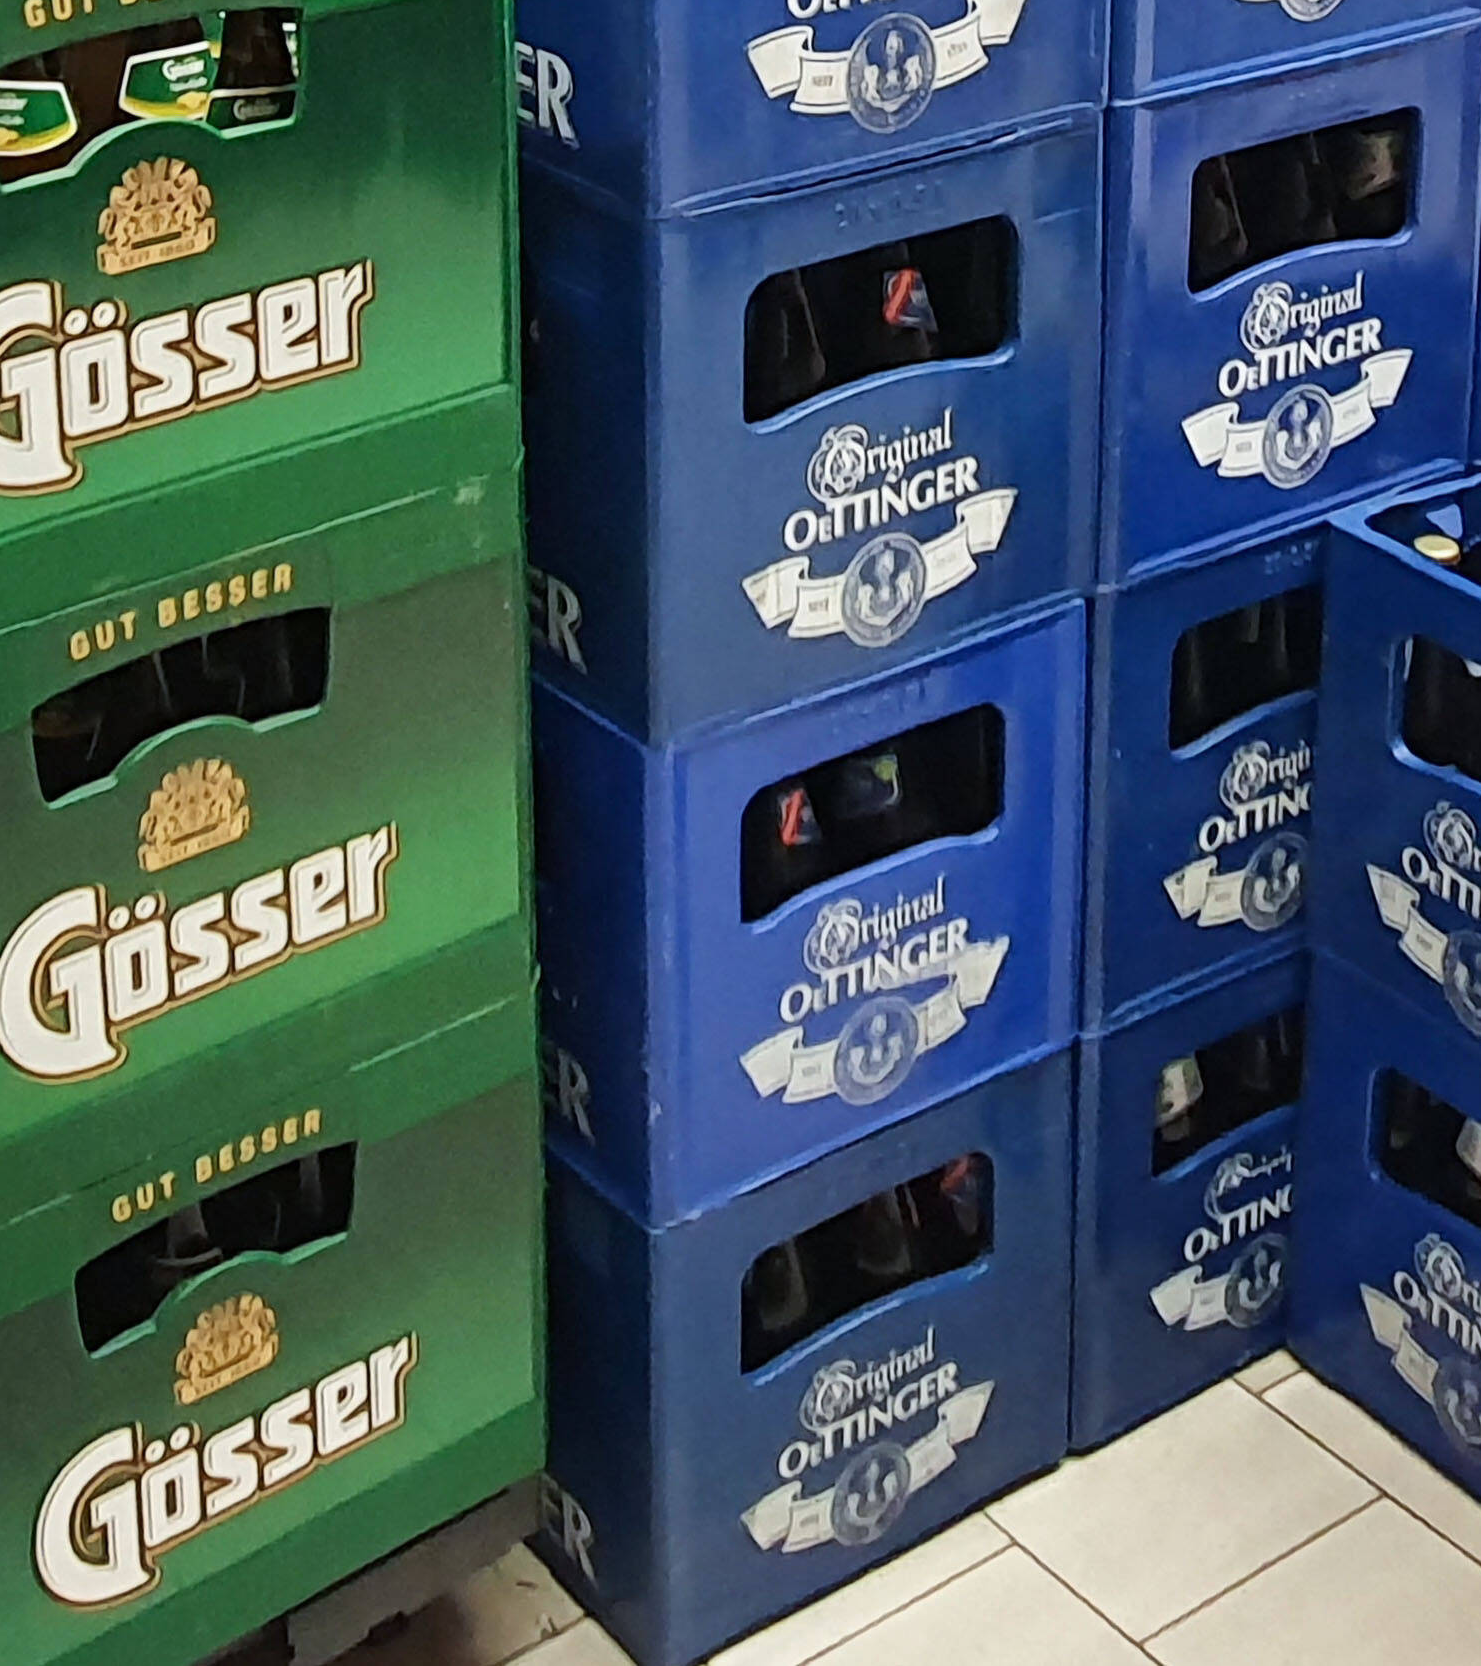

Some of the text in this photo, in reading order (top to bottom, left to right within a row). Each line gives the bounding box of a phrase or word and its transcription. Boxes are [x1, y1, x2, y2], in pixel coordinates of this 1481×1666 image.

[1239, 271, 1365, 355] Original
[806, 406, 954, 502] Original
[70, 560, 295, 664] GUT BESSER
[803, 873, 946, 975] Original
[111, 1108, 323, 1224] GUT BESSER
[800, 1326, 936, 1436] Original
[35, 1330, 419, 1610] Gösser
